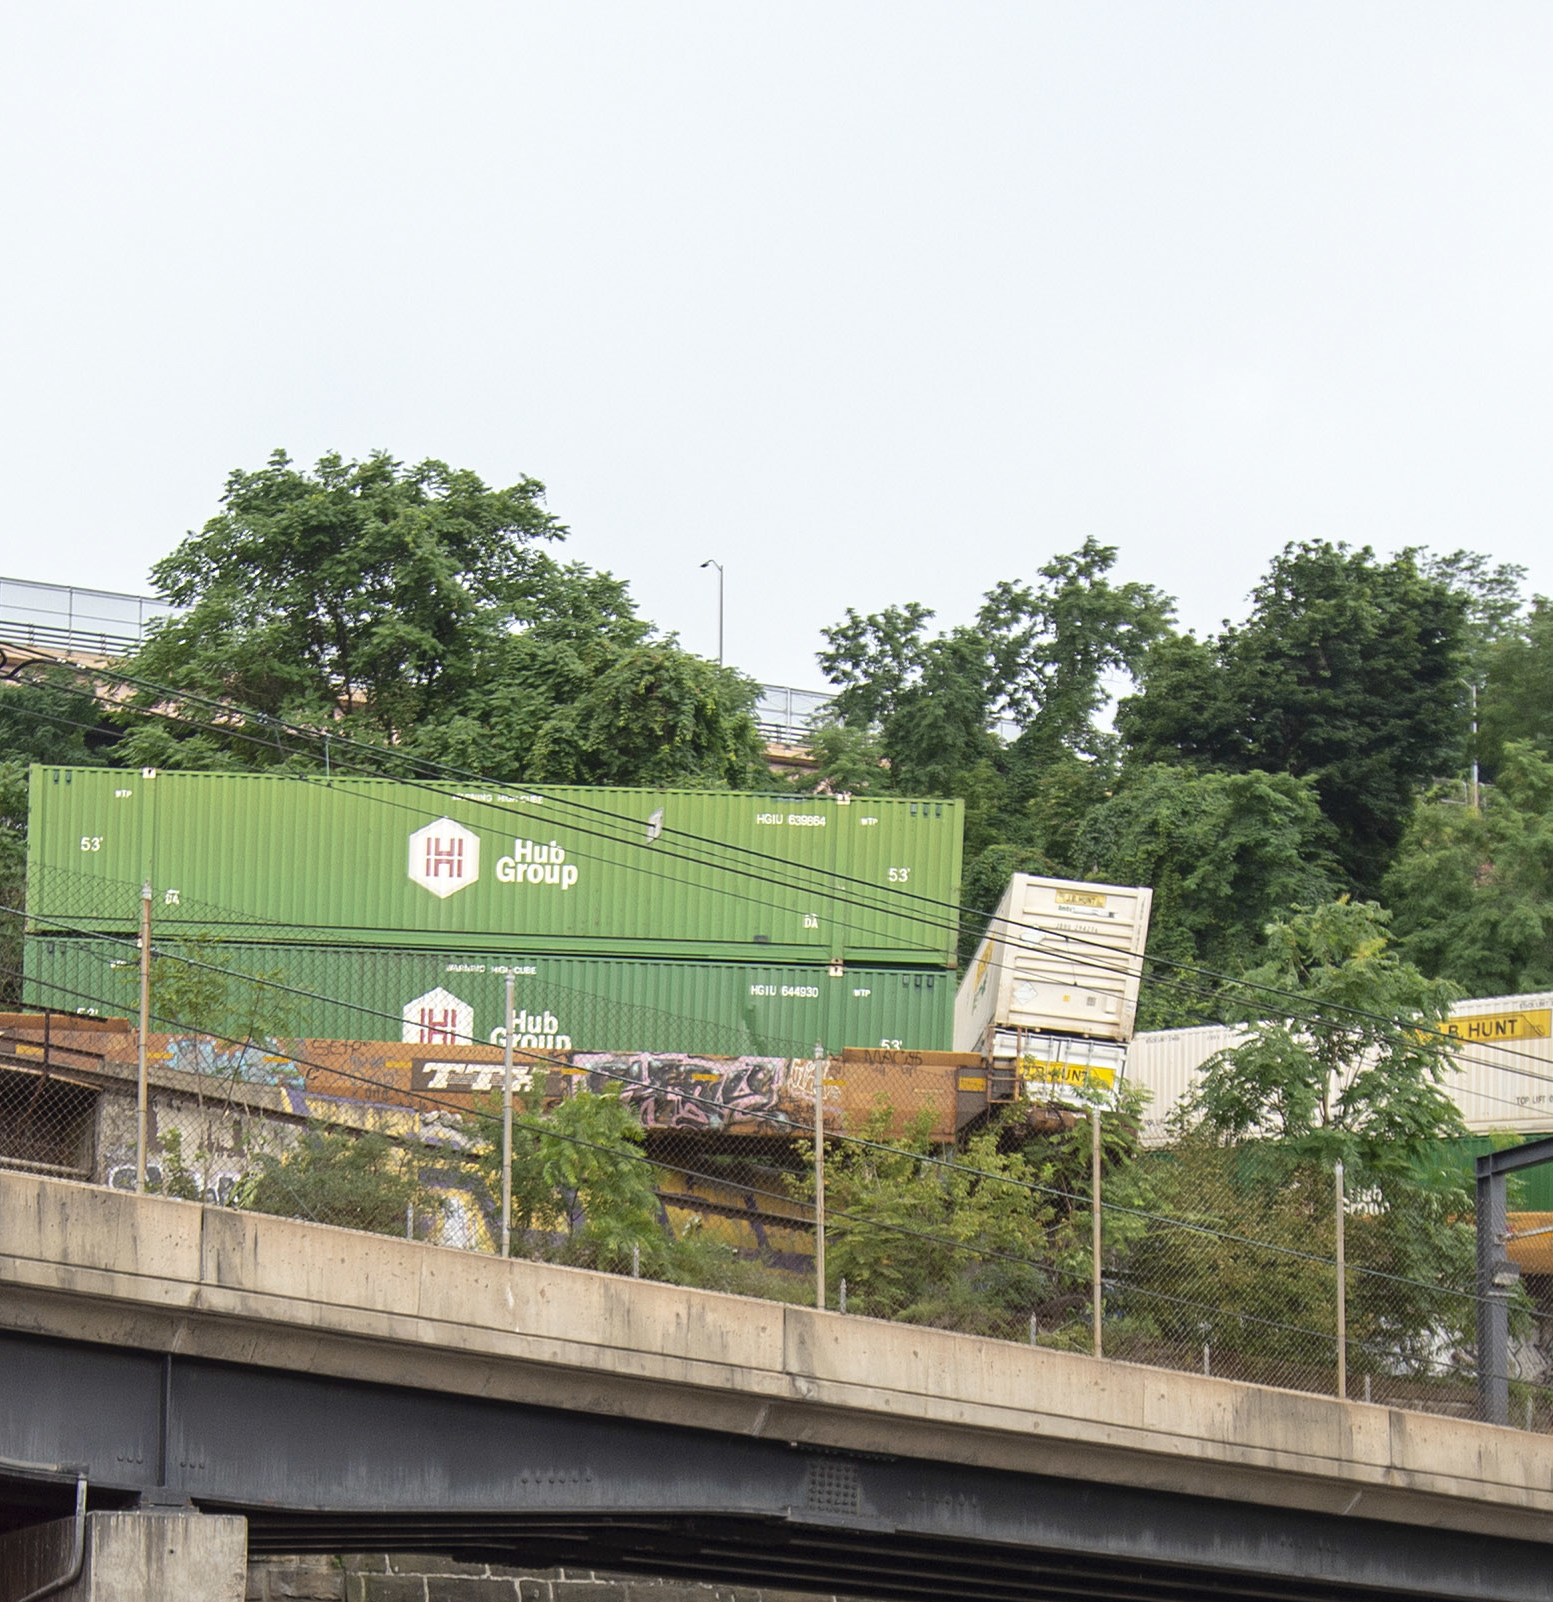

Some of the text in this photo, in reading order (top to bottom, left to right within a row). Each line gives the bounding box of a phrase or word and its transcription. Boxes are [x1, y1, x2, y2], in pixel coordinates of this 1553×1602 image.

[756, 813, 783, 825] HGIU
[80, 836, 103, 852] 53'
[514, 838, 565, 864] Hub
[496, 856, 579, 890] Group
[888, 867, 911, 883] 53'
[750, 984, 819, 998] HGIU 644930
[511, 1008, 559, 1035] Hub
[1468, 1018, 1518, 1039] HUNT
